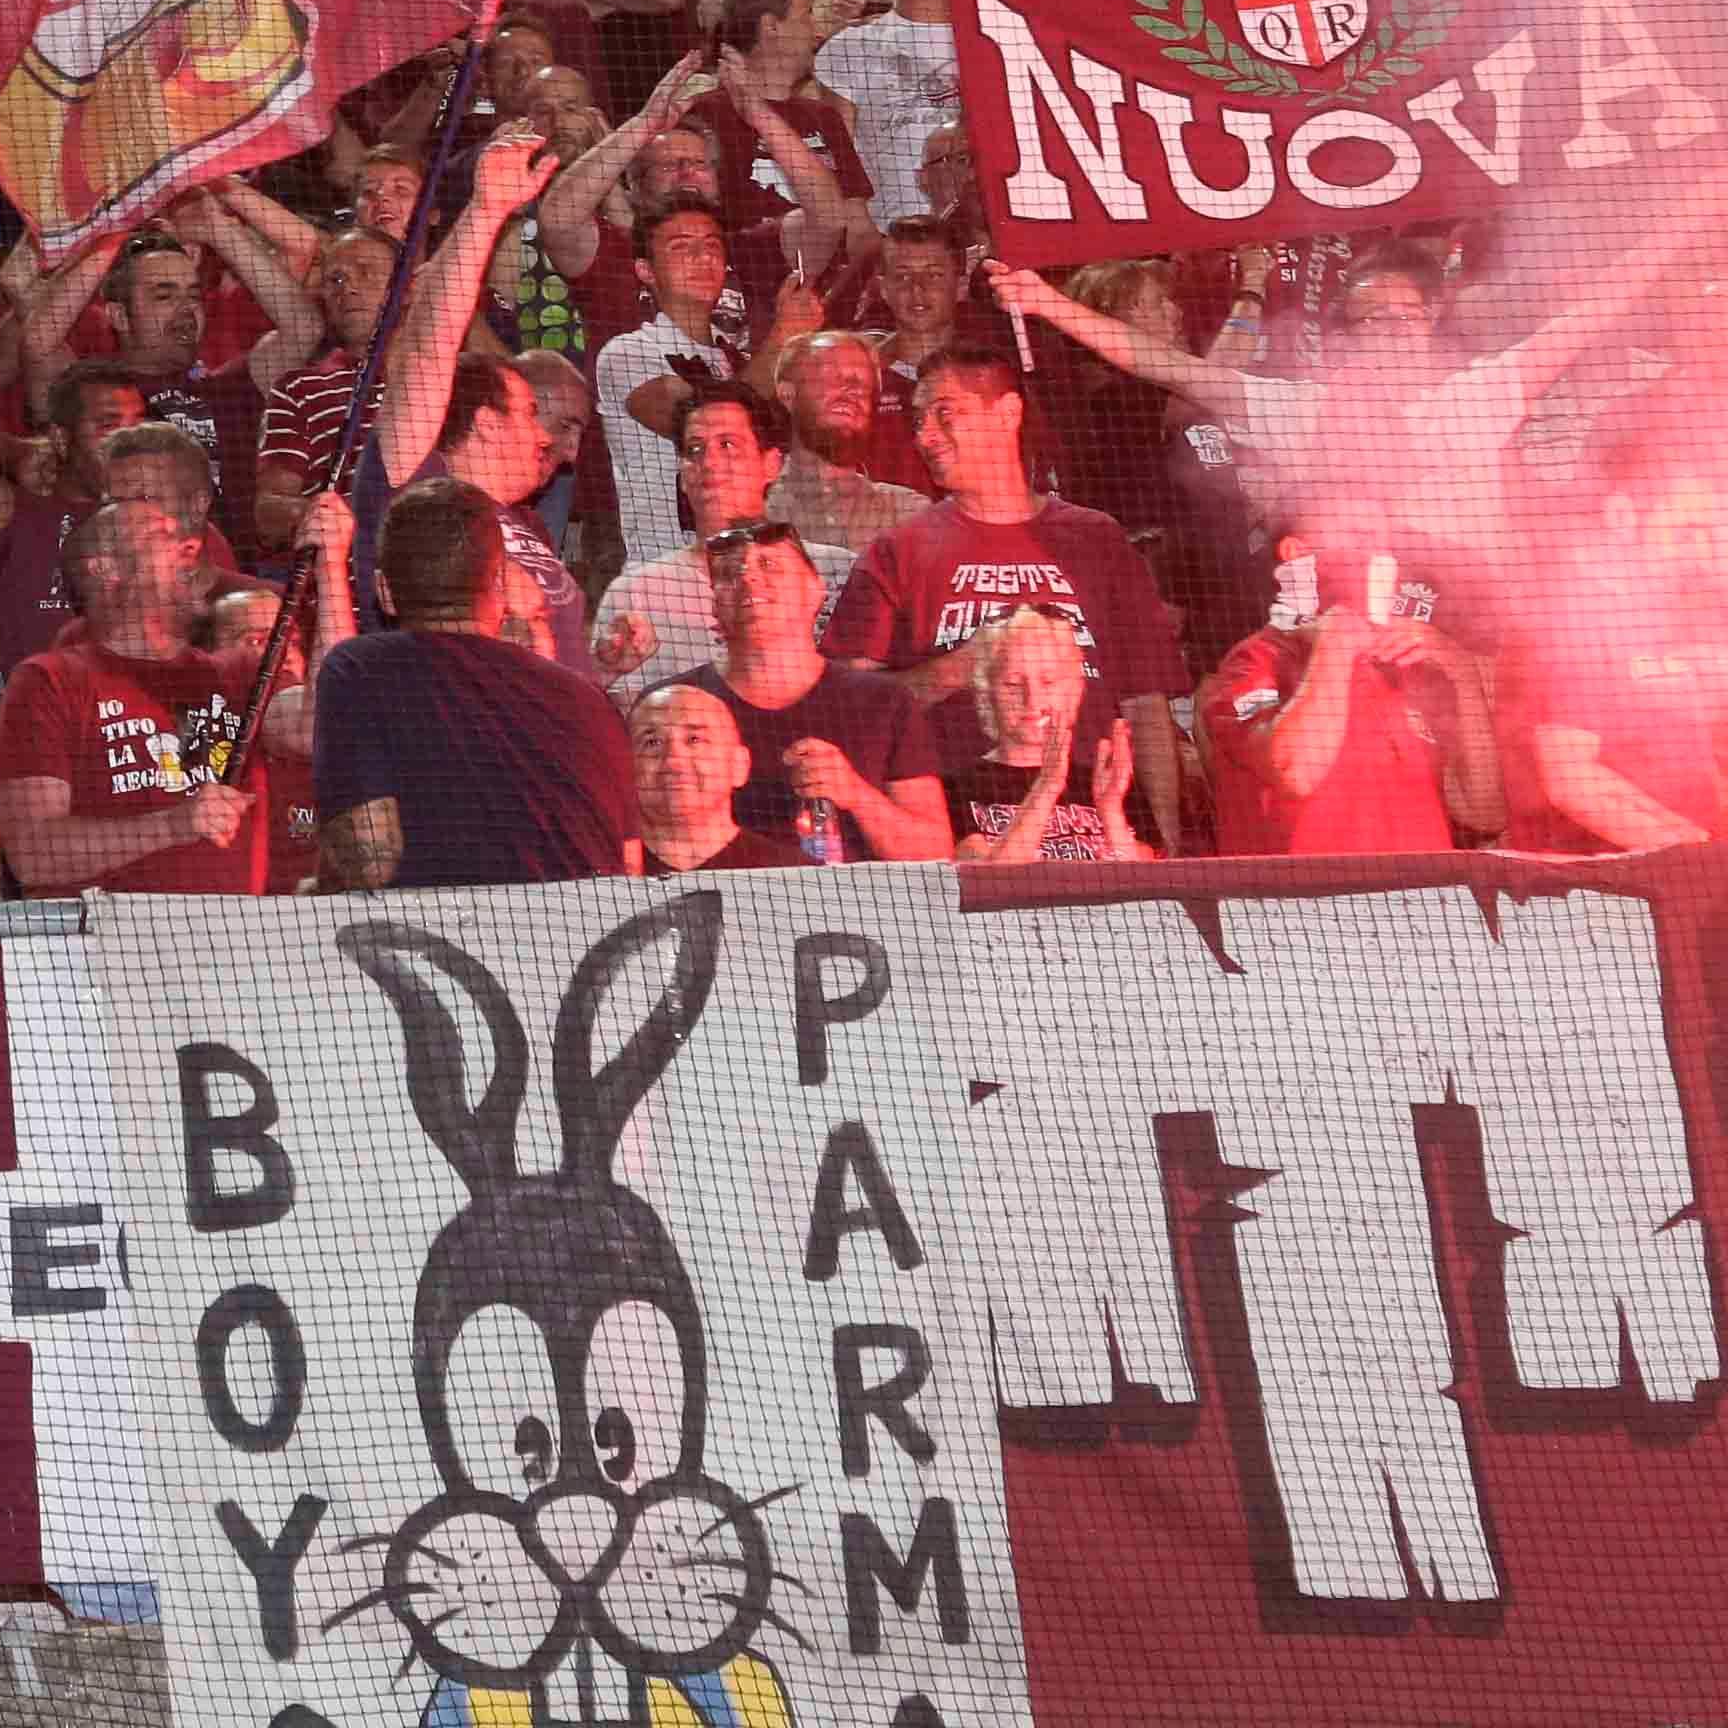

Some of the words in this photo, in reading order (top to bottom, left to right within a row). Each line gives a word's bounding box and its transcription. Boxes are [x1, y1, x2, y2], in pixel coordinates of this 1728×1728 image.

[950, 563, 1075, 596] TESTE
[97, 699, 125, 719] IO
[100, 717, 157, 743] TIFO
[107, 744, 137, 769] LA
[793, 931, 972, 1728] PARM
[176, 1042, 344, 1728] BOY
